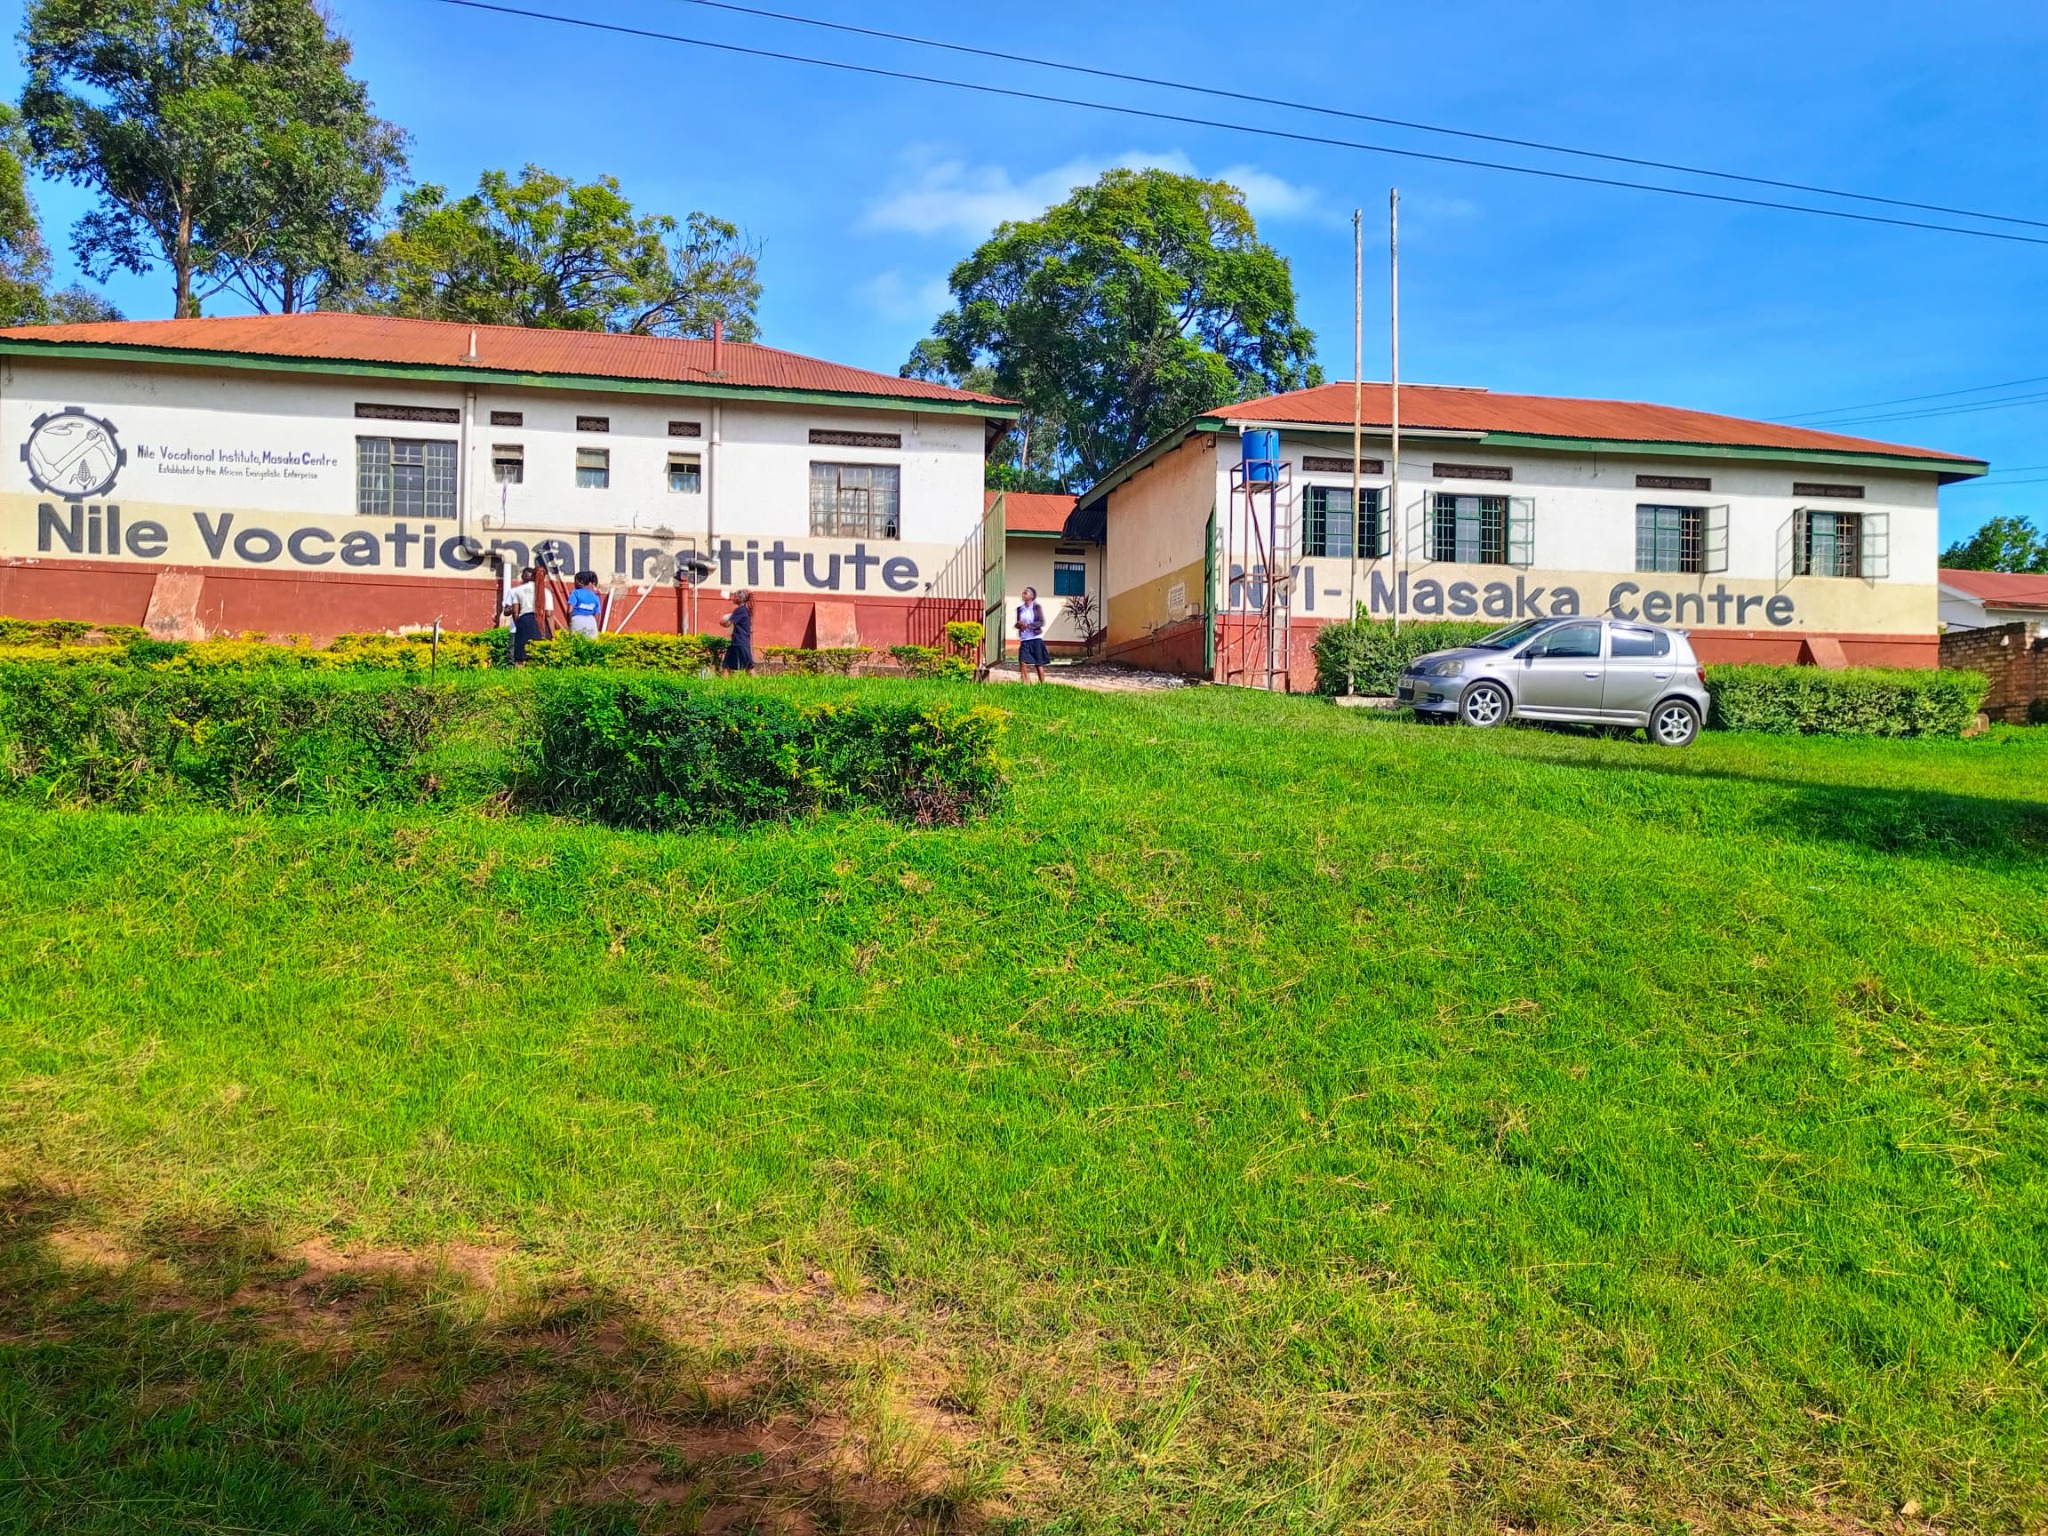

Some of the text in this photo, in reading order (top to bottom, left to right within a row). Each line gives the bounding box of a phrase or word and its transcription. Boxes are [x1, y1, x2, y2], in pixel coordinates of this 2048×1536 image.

[137, 444, 338, 466] Nile Vocational Institute, Masaka Centre
[158, 463, 195, 475] Established
[197, 465, 205, 476] by
[206, 466, 217, 475] the
[219, 466, 243, 477] African
[283, 469, 318, 480] Enterprise
[38, 502, 169, 558] Nile
[1370, 569, 1580, 618] Masaka
